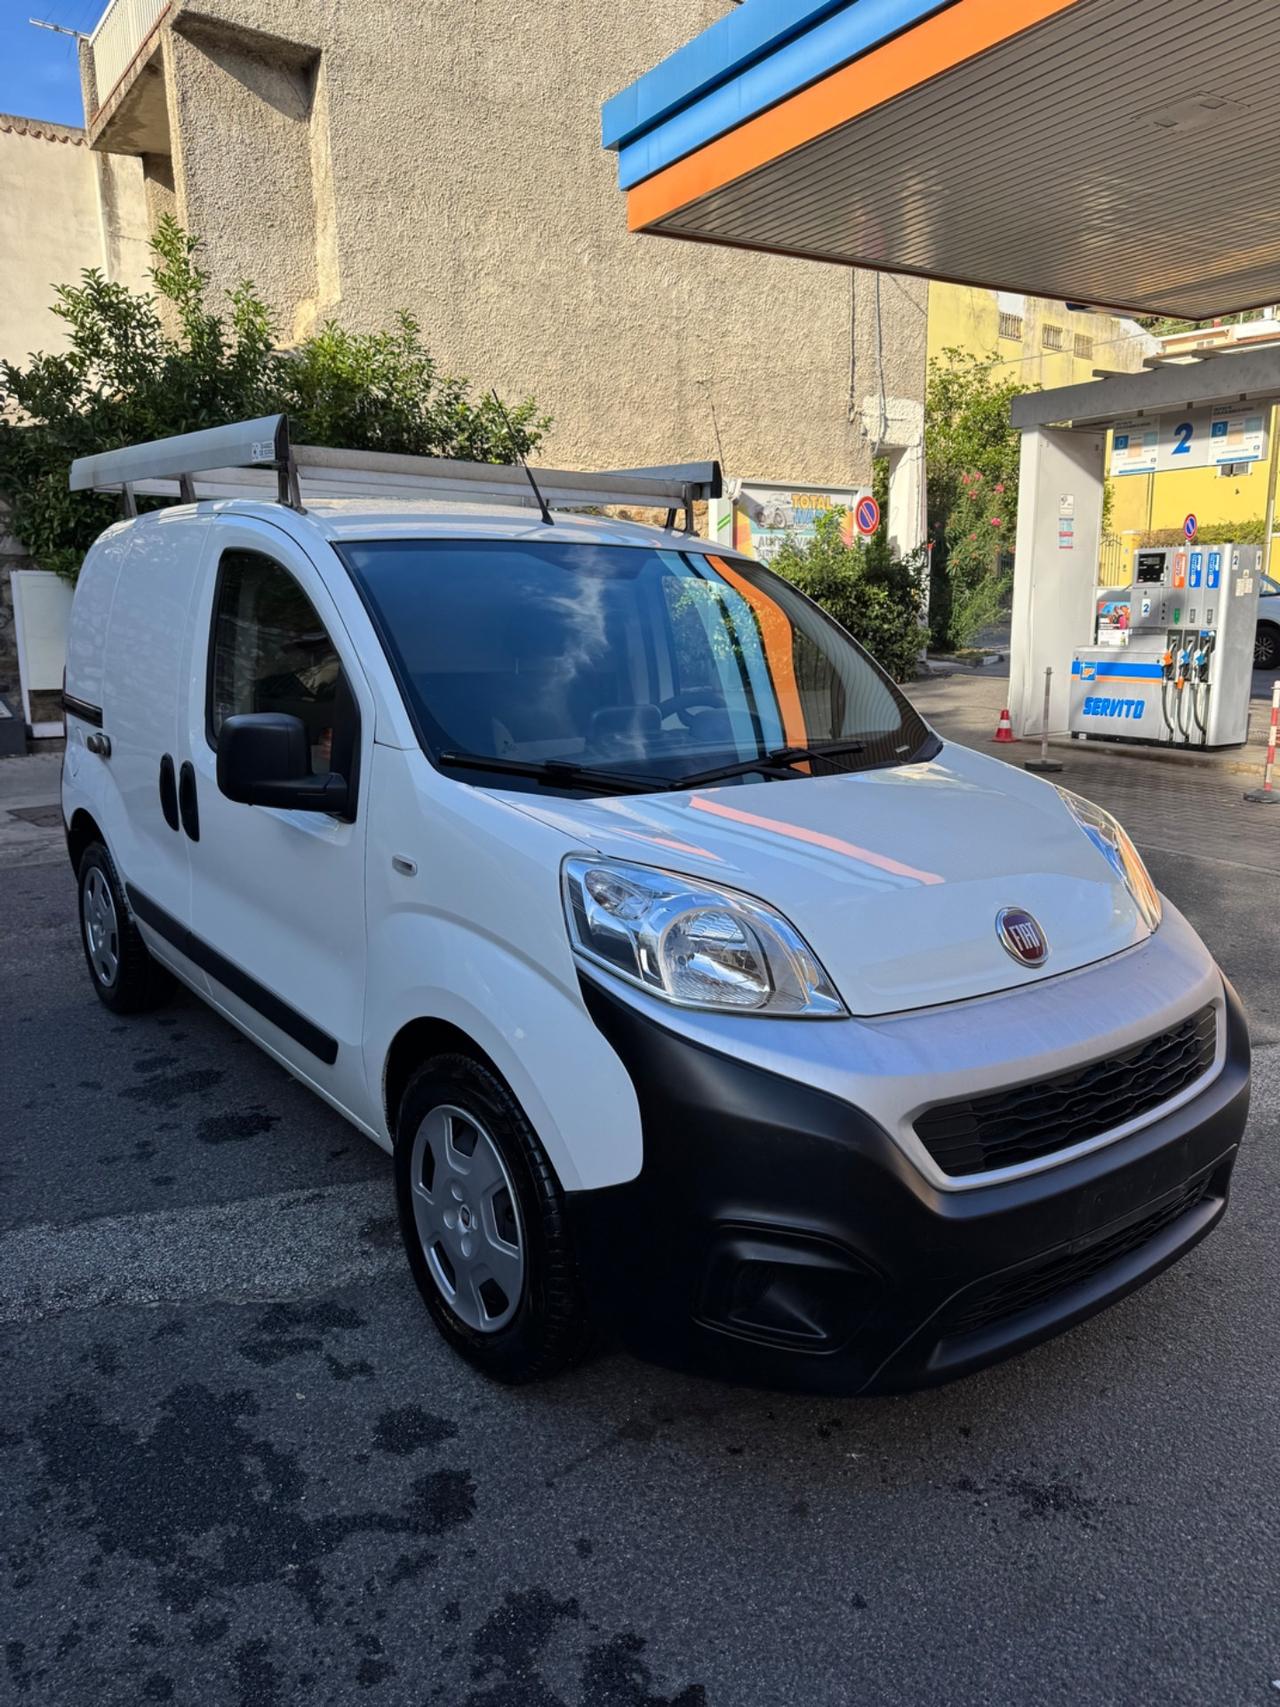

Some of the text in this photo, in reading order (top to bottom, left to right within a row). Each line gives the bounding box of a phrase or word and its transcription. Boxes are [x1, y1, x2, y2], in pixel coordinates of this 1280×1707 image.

[1171, 422, 1194, 455] 2
[791, 494, 833, 509] TOTAL
[1143, 604, 1150, 613] 2
[1083, 697, 1145, 719] SERVITO
[1009, 922, 1040, 951] FIAT
